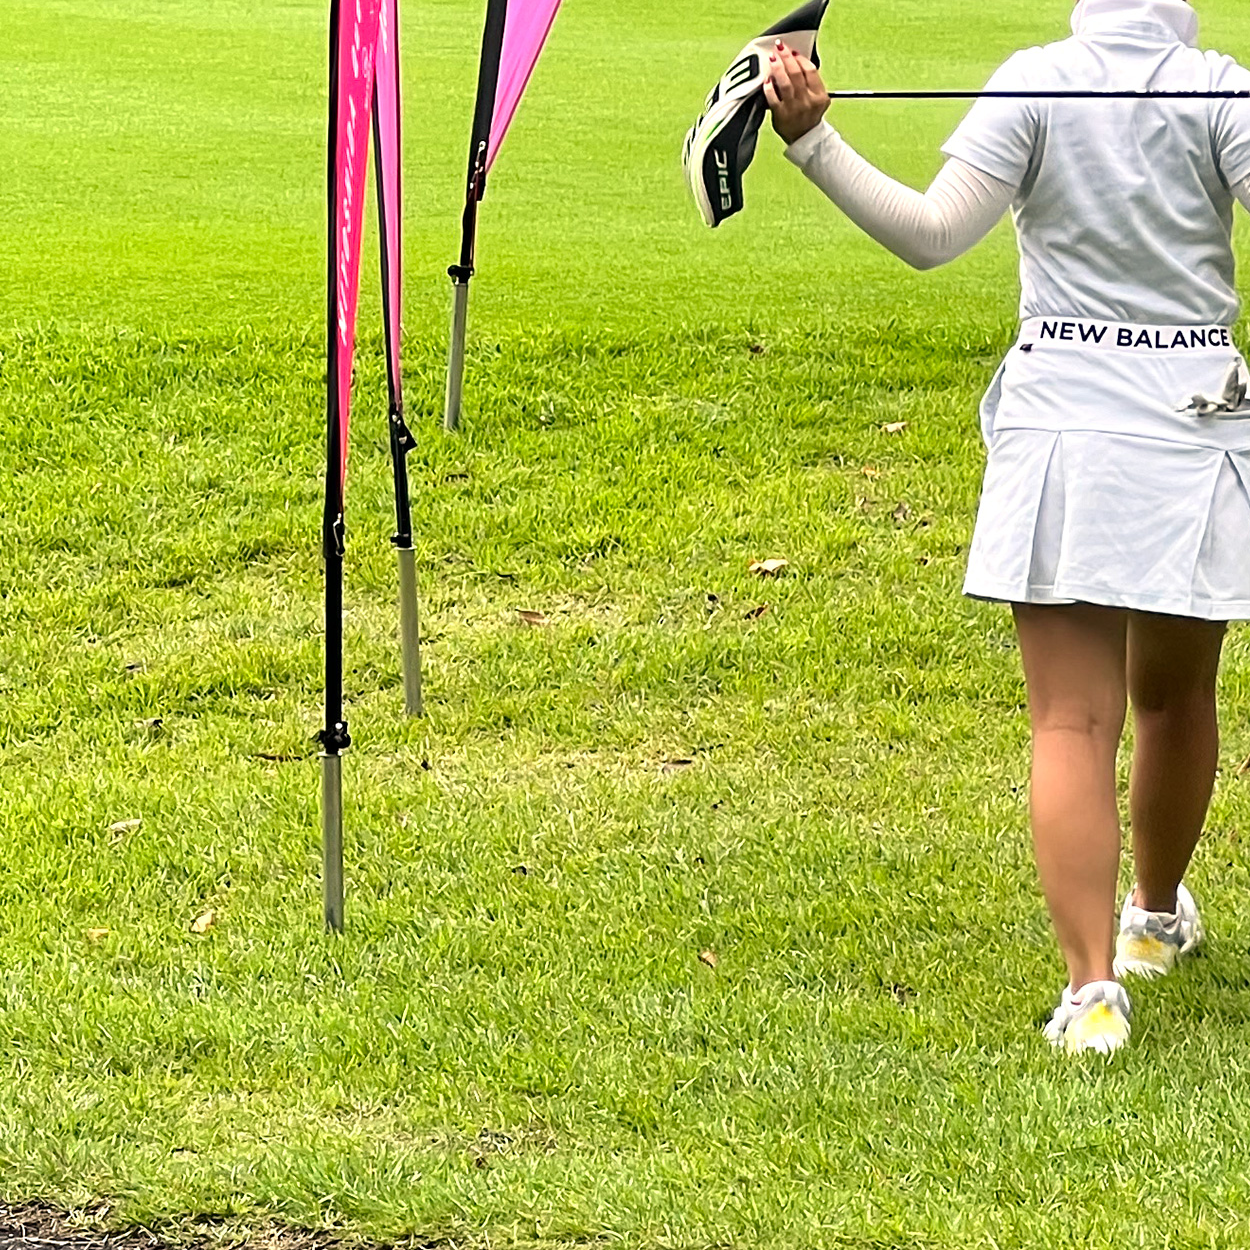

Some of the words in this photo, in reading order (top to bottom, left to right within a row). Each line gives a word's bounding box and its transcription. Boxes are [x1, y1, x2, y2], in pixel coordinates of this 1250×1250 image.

[713, 149, 732, 211] EPIC
[1040, 321, 1108, 344] NEW
[1116, 328, 1230, 349] BALANCE
